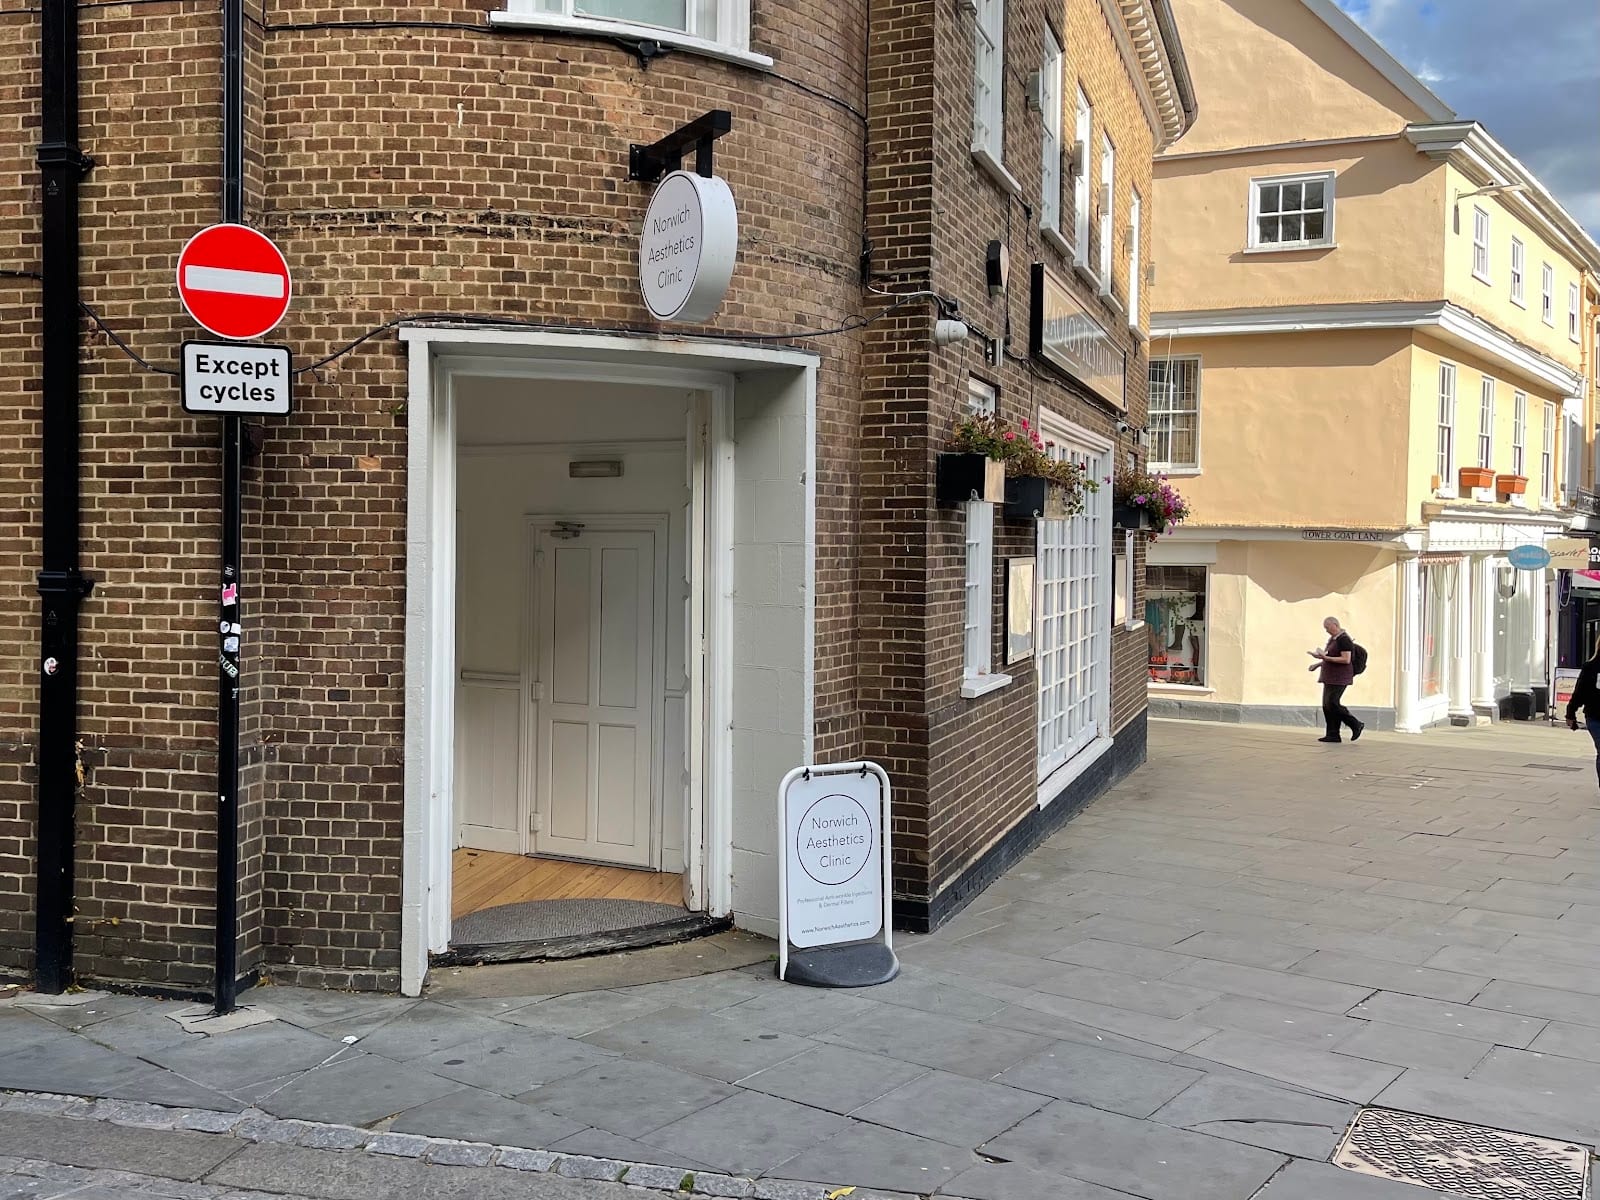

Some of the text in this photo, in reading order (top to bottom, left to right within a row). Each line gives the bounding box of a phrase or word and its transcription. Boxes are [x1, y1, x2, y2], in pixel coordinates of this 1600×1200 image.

[653, 204, 691, 235] Norwich
[647, 235, 695, 265] Aesthetics
[657, 267, 683, 289] Clinic
[196, 354, 280, 380] Except
[199, 382, 276, 404] cycles
[812, 813, 858, 829] Norwich
[806, 833, 865, 849] Aesthetics
[820, 854, 851, 868] Clinic
